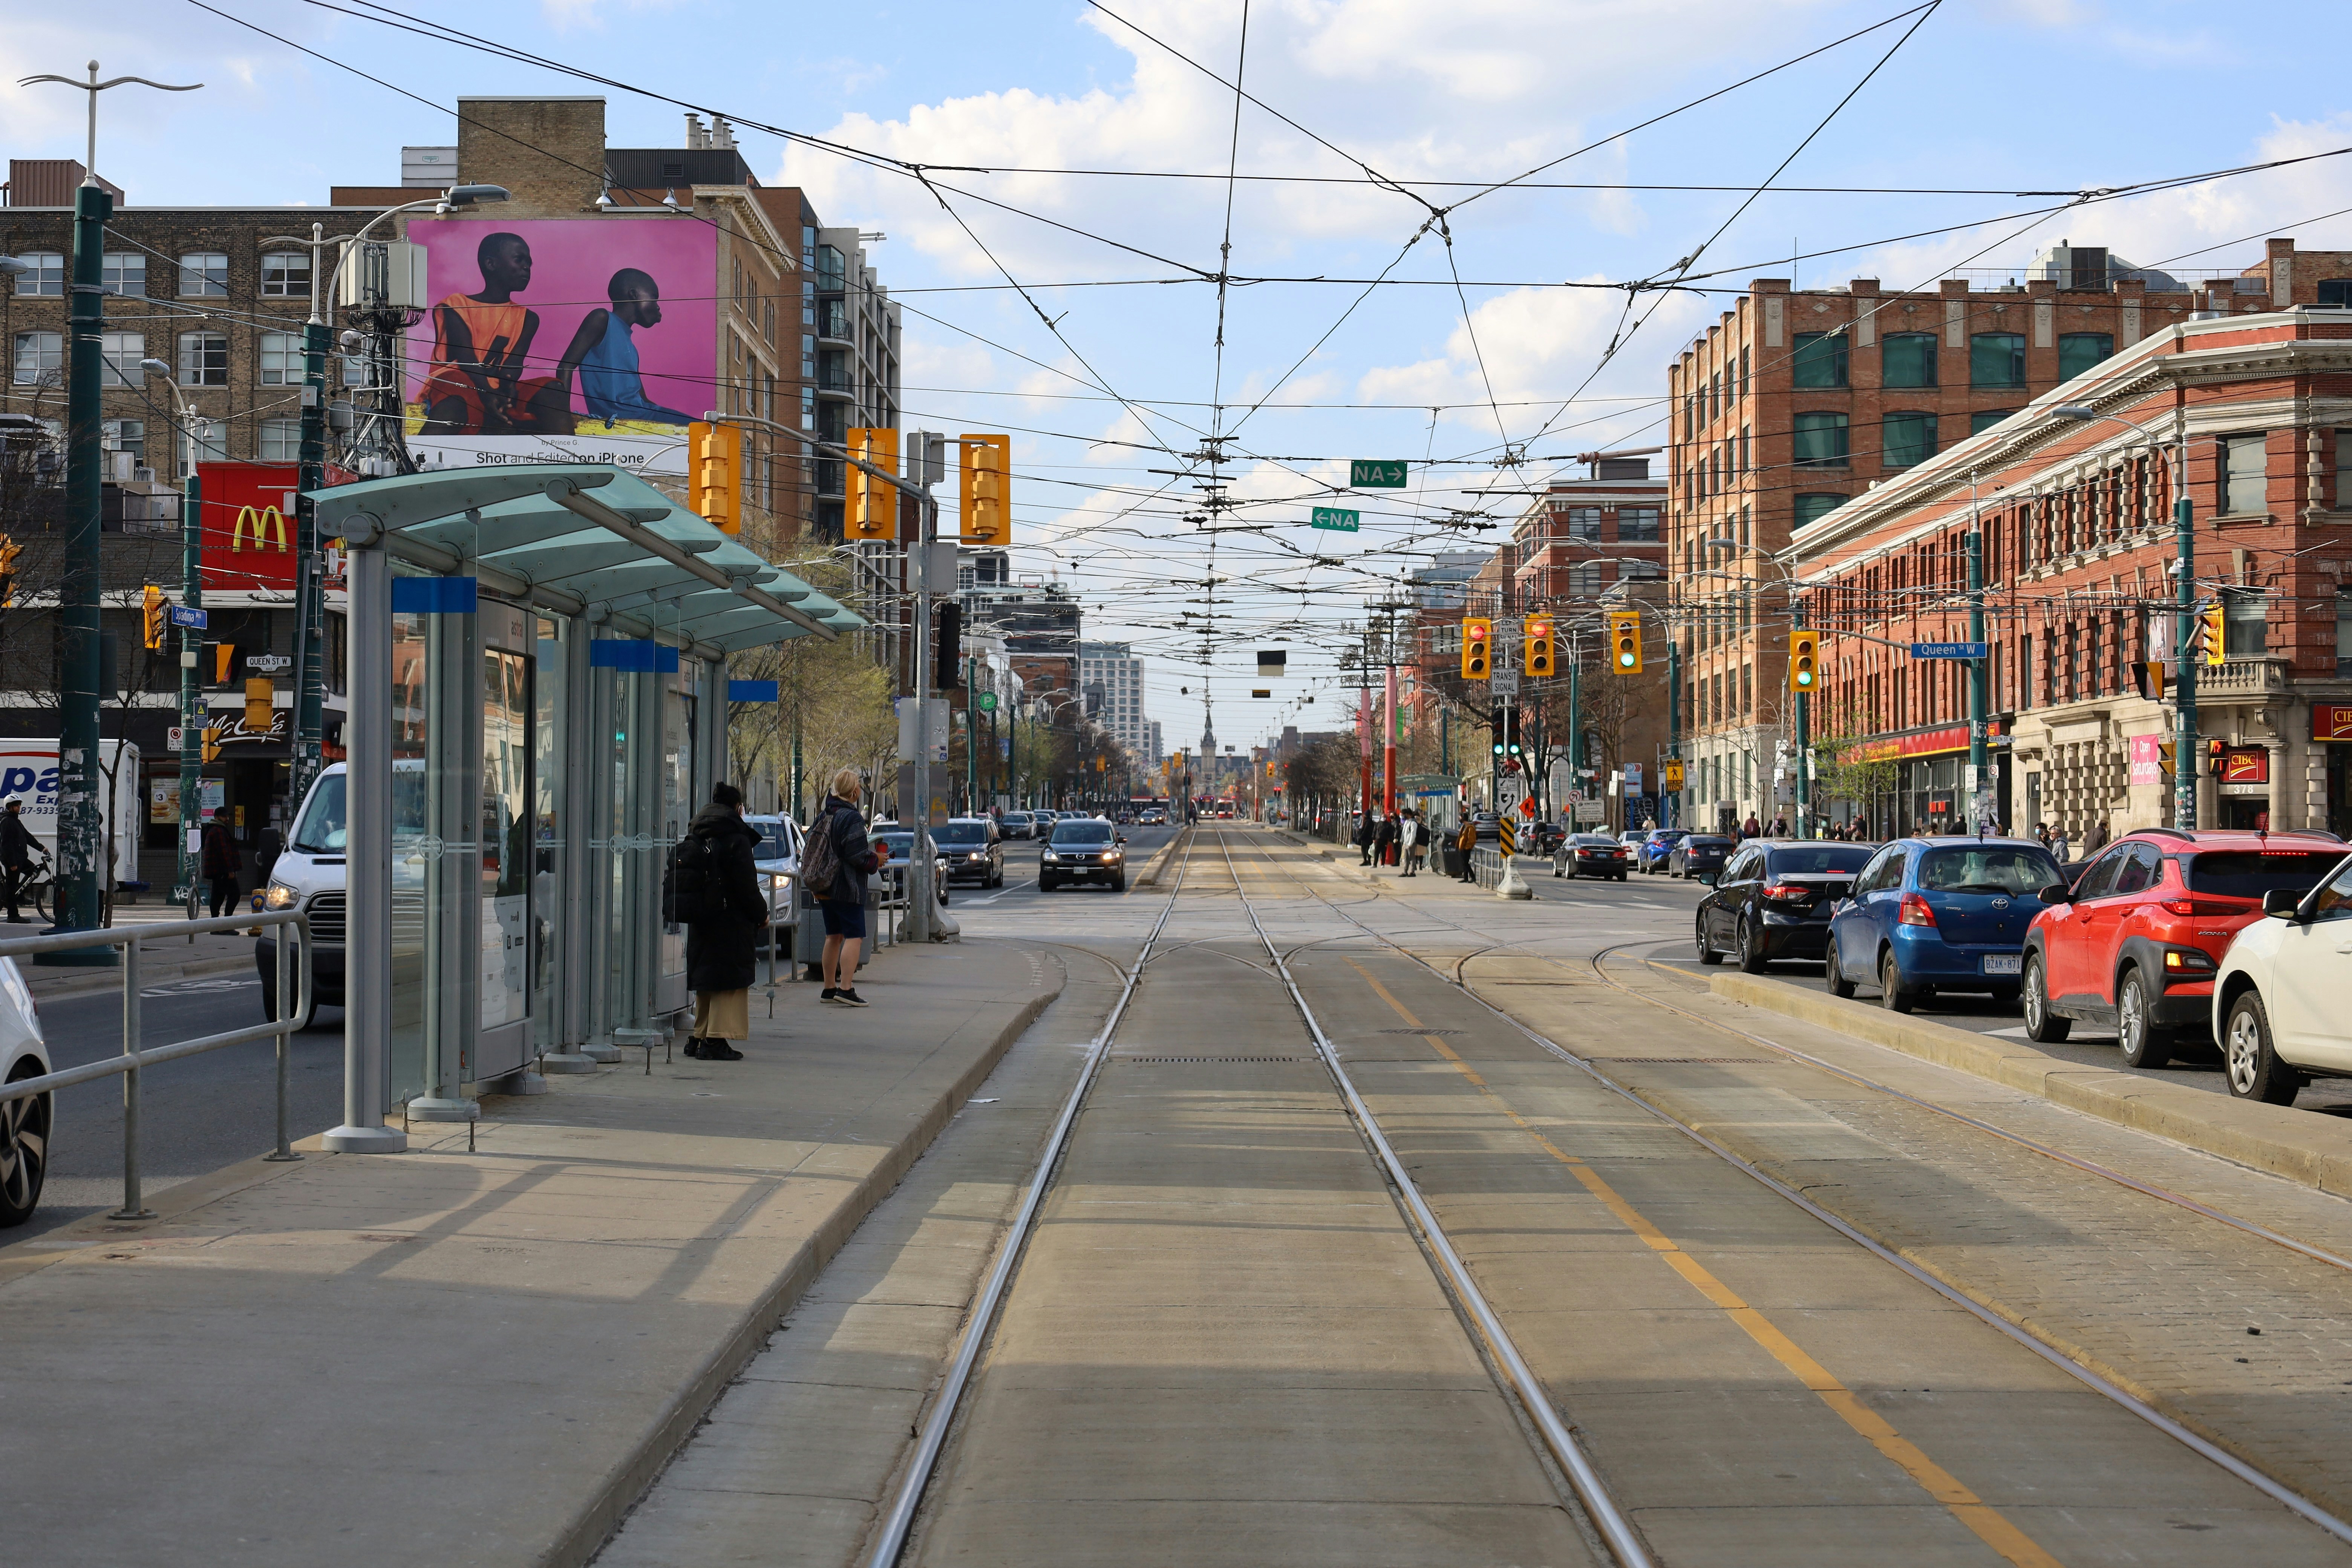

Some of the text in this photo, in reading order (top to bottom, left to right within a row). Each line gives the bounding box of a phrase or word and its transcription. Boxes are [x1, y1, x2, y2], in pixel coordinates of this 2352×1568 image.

[476, 453, 507, 464] Shot
[511, 452, 533, 463] and
[537, 452, 575, 463] Edited
[599, 452, 644, 463] iPhone
[1354, 466, 1385, 482] NA
[1329, 512, 1355, 527] NA
[175, 608, 194, 623] Spadina
[511, 619, 523, 637] astral
[1922, 644, 1956, 655] Queen
[1966, 644, 1975, 654] W
[1493, 672, 1516, 681] TRANSIT
[1495, 683, 1515, 692] SIGNAL
[2139, 740, 2150, 756] Open
[2231, 755, 2256, 765] CIBC
[2132, 757, 2159, 779] Saturdays!
[2234, 784, 2254, 794] 378
[1986, 959, 2020, 969] BZAK 871
